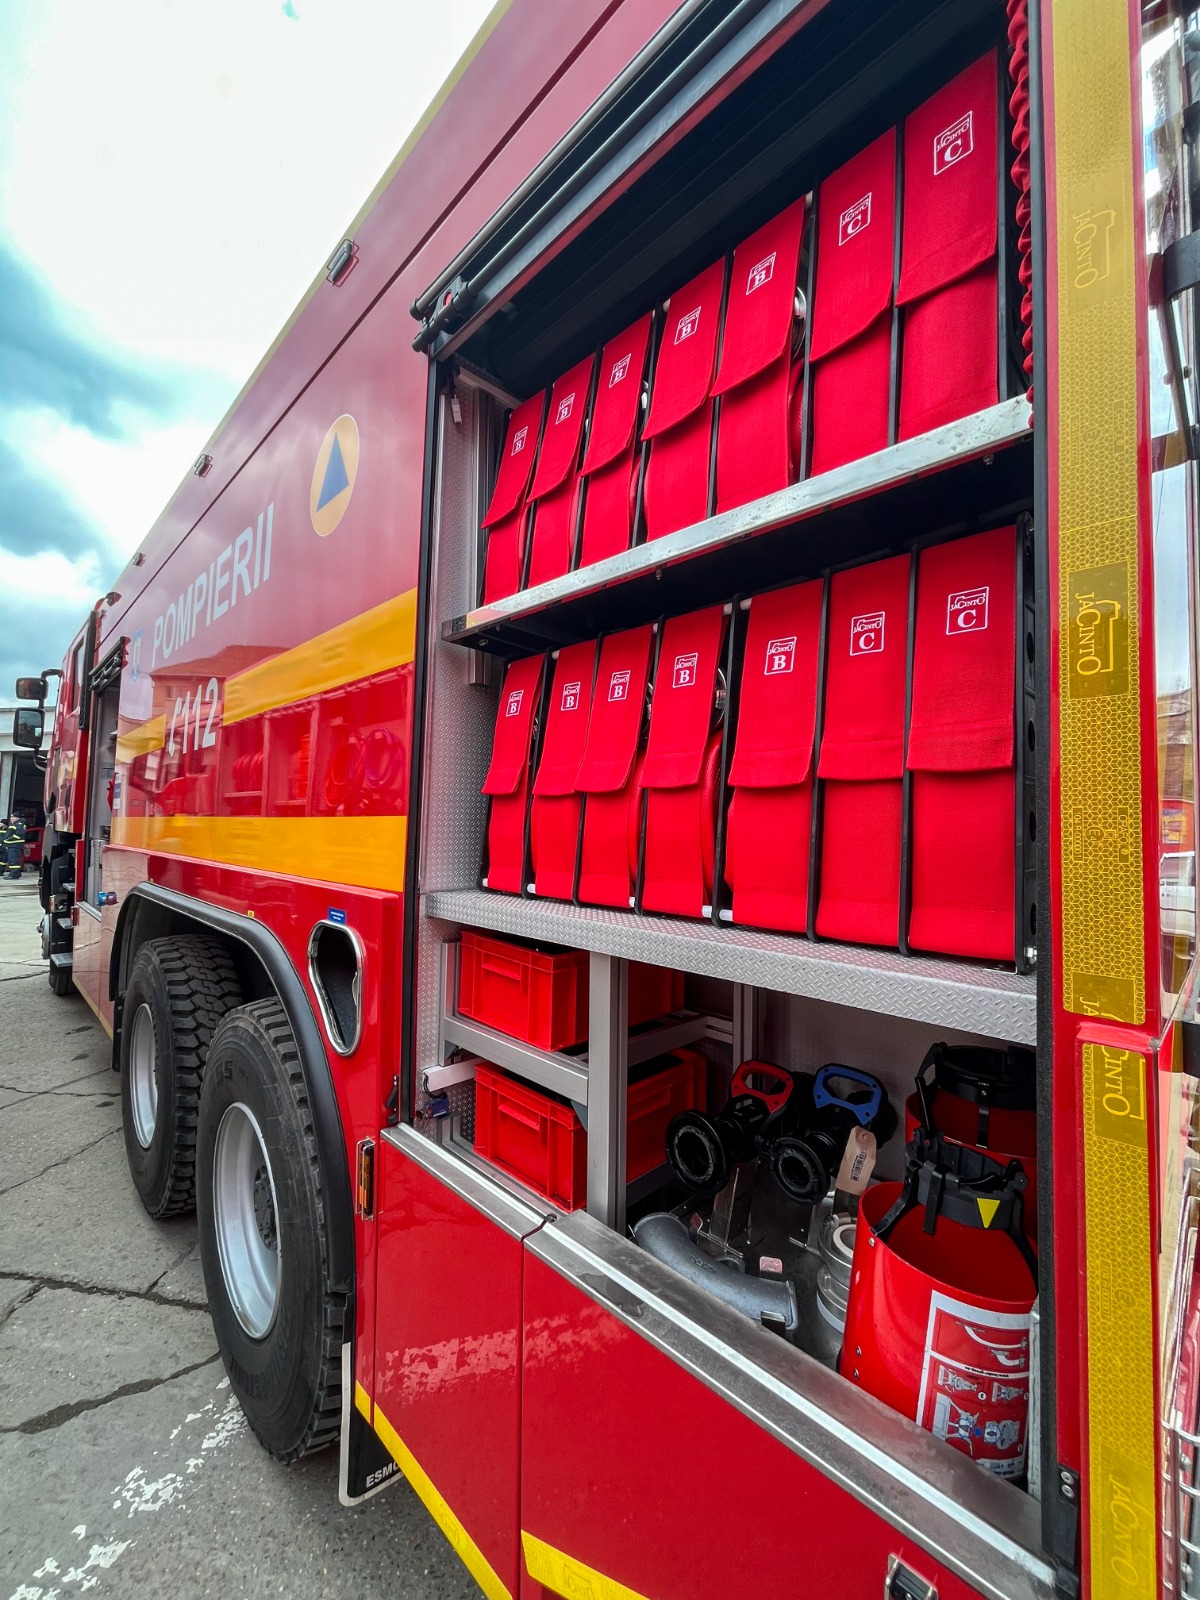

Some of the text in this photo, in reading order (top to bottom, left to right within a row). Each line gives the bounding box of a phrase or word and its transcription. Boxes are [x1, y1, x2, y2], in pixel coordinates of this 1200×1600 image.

[936, 121, 970, 152] JACINTO
[944, 138, 963, 162] C
[846, 215, 862, 234] C
[1072, 208, 1098, 289] JACINTO
[753, 269, 766, 288] B
[681, 323, 691, 338] B
[151, 500, 275, 668] POMPIERII
[949, 597, 985, 611] JACINTO
[957, 610, 976, 628] C
[858, 632, 875, 650] C
[1075, 592, 1101, 676] JACINTO
[771, 655, 786, 671] B
[678, 669, 690, 684] B
[613, 685, 623, 698] B
[565, 696, 574, 708] B
[180, 677, 219, 755] 112
[1108, 1474, 1139, 1586] JACINTO
